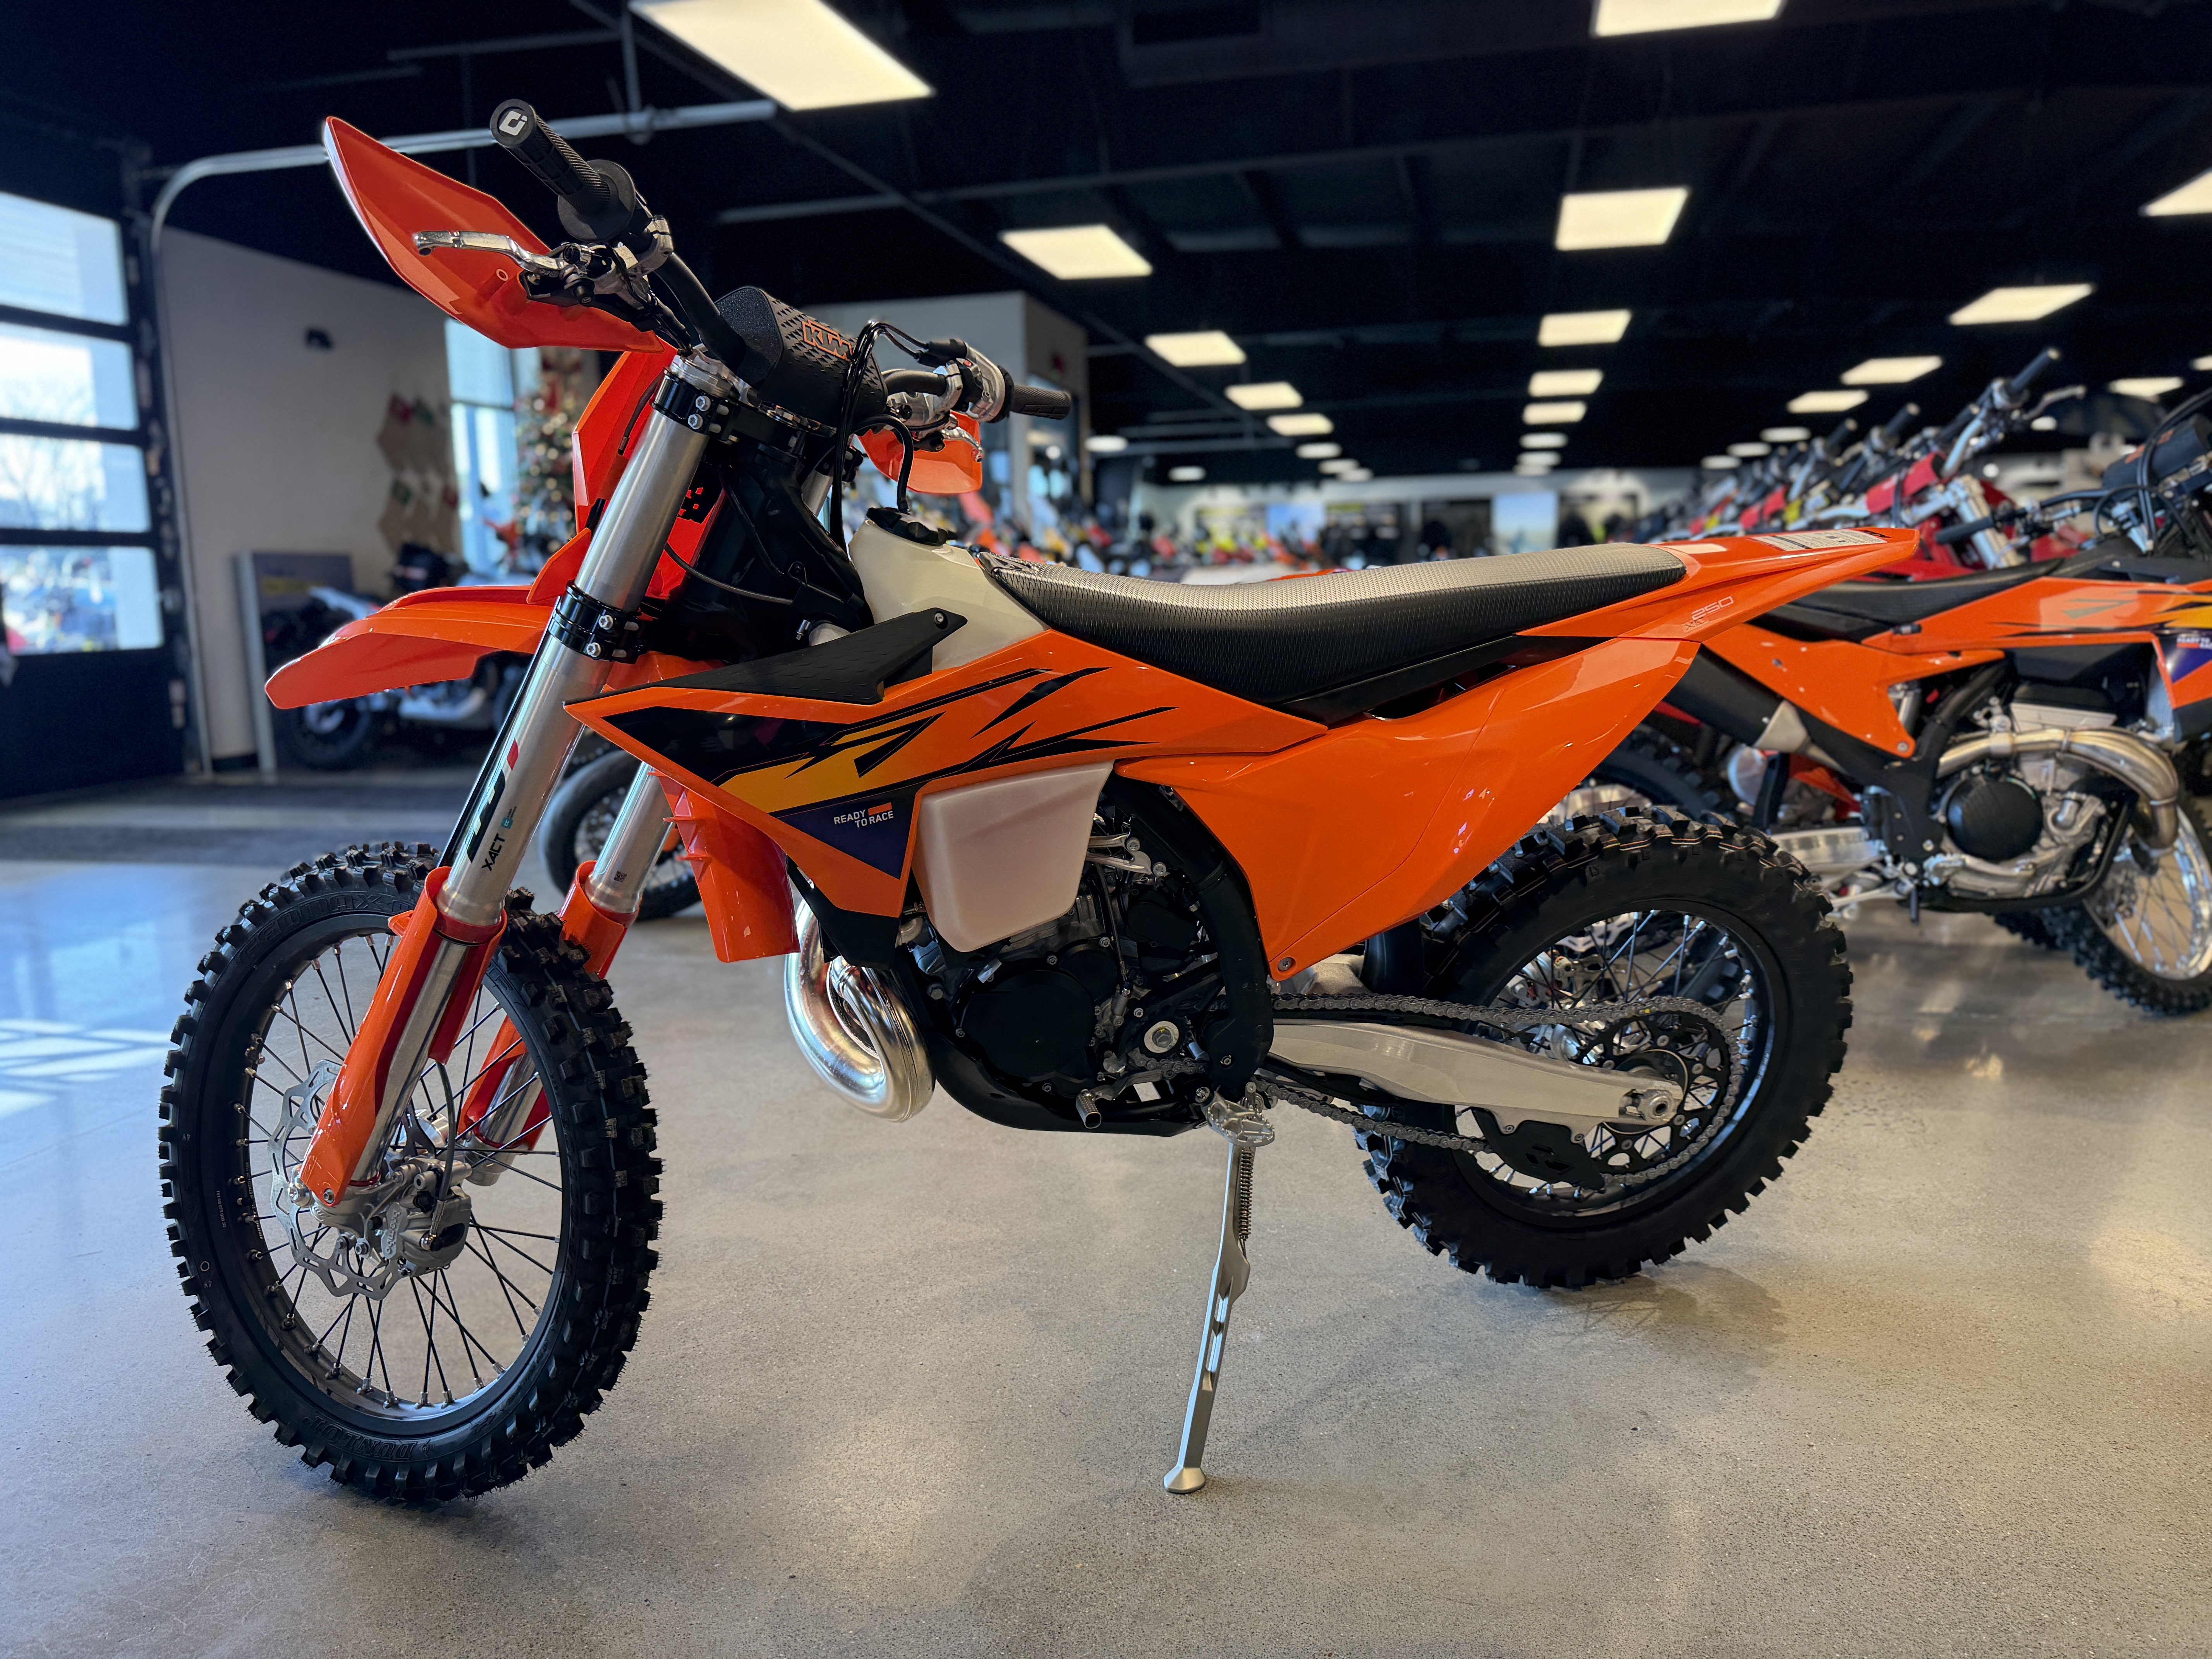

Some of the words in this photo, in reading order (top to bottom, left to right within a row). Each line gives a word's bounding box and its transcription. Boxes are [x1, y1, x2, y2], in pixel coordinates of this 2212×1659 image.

[802, 320, 852, 362] KTM
[1691, 596, 1734, 620] 250
[834, 809, 866, 824] READY
[855, 818, 867, 828] TO
[869, 811, 894, 824] RACE
[481, 833, 505, 872] XACT
[239, 894, 382, 965] GEOMAX
[385, 1210, 401, 1254] brembo
[302, 1416, 403, 1460] DUNLOP
